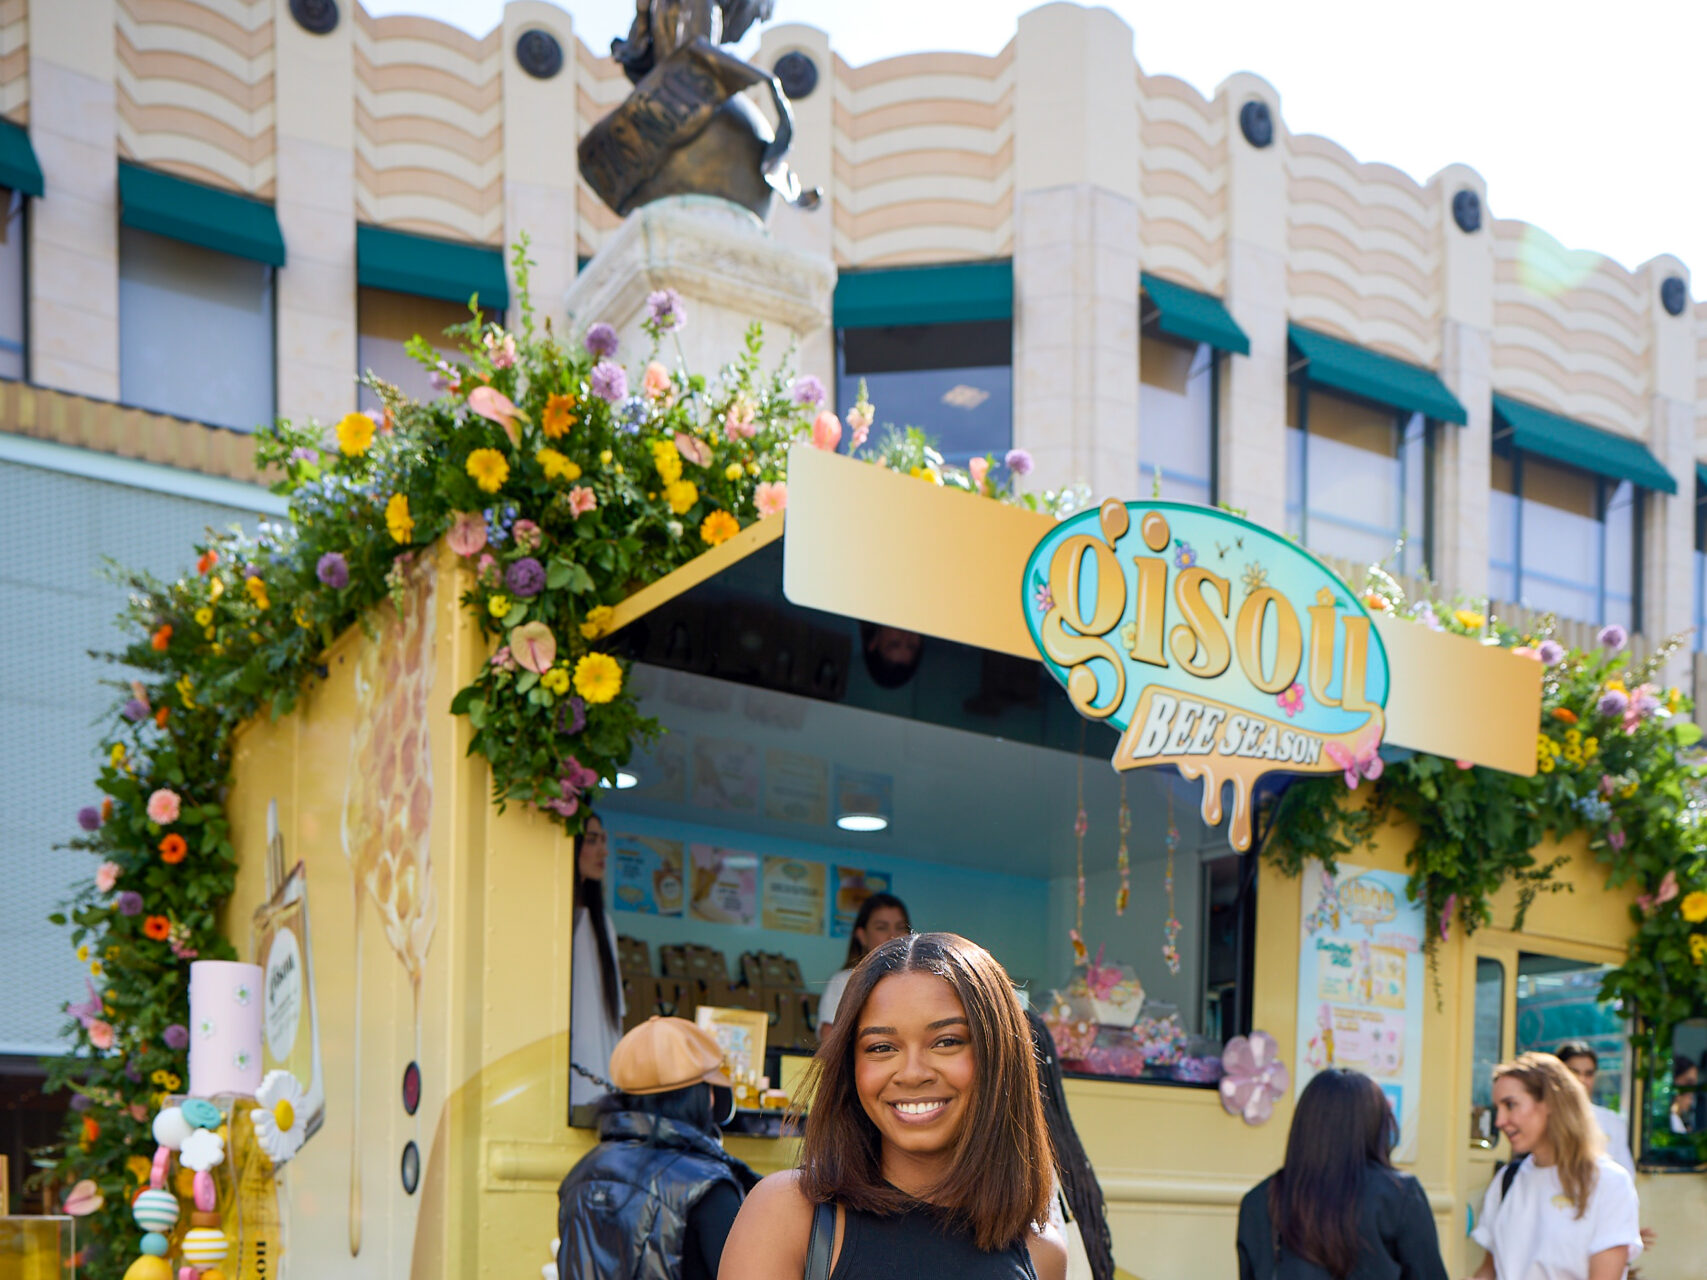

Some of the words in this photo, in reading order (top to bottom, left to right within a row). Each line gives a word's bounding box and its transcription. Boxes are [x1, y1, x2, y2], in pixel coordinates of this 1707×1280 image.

[1042, 498, 1372, 718] gisou
[1132, 693, 1226, 759] BEE
[1218, 714, 1323, 764] SEASON
